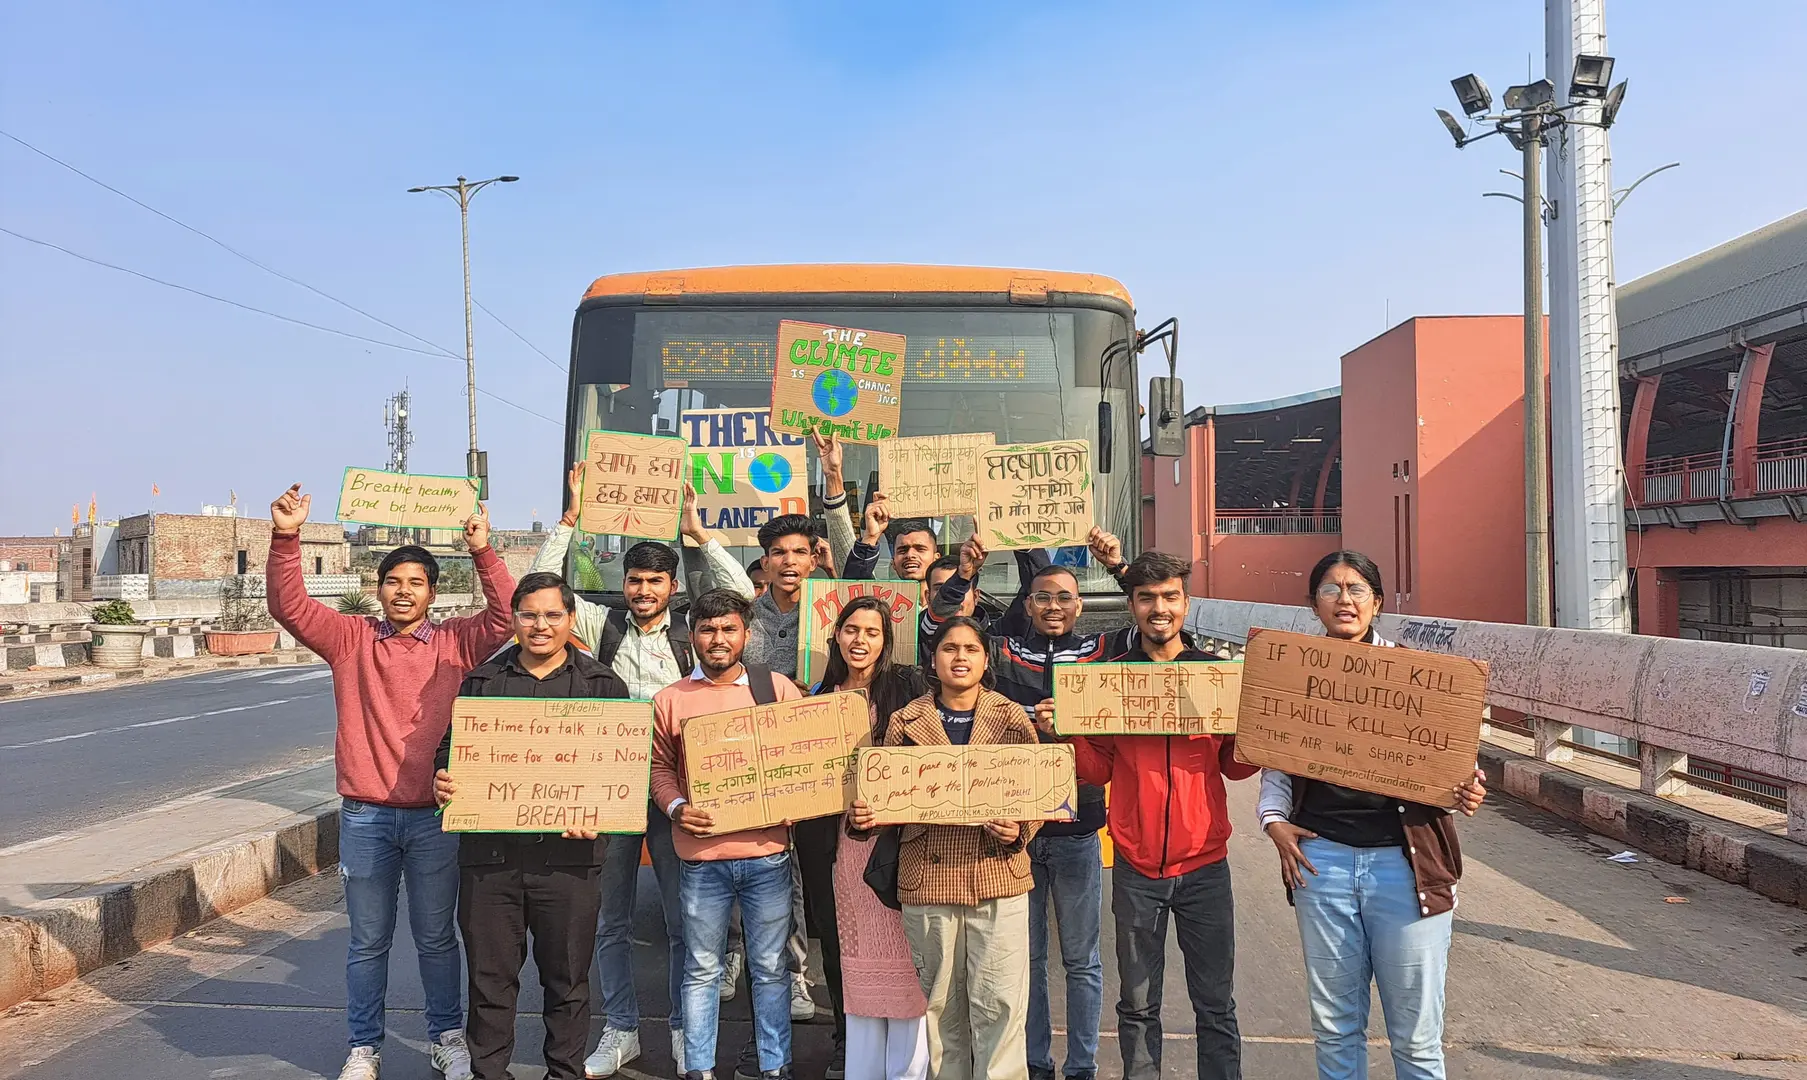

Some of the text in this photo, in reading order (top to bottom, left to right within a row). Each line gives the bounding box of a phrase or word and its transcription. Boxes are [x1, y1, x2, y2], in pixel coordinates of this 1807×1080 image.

[822, 328, 867, 347] THE
[789, 338, 898, 376] CLIMTE
[790, 368, 805, 379] IS
[738, 447, 757, 459] IS
[594, 451, 683, 479] साफ हवा
[350, 473, 460, 498] Breathe healthy
[596, 482, 678, 505] हक हमारा
[351, 497, 458, 516] and be healthy
[697, 507, 780, 529] LANET
[1200, 666, 1238, 689] से
[1266, 642, 1462, 695] IF YOU DON'T KILL
[1114, 695, 1160, 711] बचाना
[1305, 674, 1424, 718] POLLUTION
[458, 715, 488, 733] The
[494, 717, 524, 733] time
[529, 718, 550, 736] for
[558, 720, 585, 736] talk
[596, 722, 608, 736] is
[1259, 695, 1450, 752] IT WILL KILL YOU
[454, 745, 649, 764] The time for act is Now
[1299, 736, 1323, 751] AIR
[1335, 740, 1355, 756] WE
[866, 753, 892, 782] Be
[901, 765, 911, 776] a
[918, 761, 942, 778] part
[946, 761, 958, 772] of
[963, 758, 978, 769] the
[1039, 756, 1064, 770] not
[488, 782, 630, 801] MY RIGHT TO
[872, 793, 880, 802] a
[886, 786, 920, 806] part
[926, 784, 942, 798] of
[944, 781, 962, 792] the
[515, 804, 599, 827] BREATH
